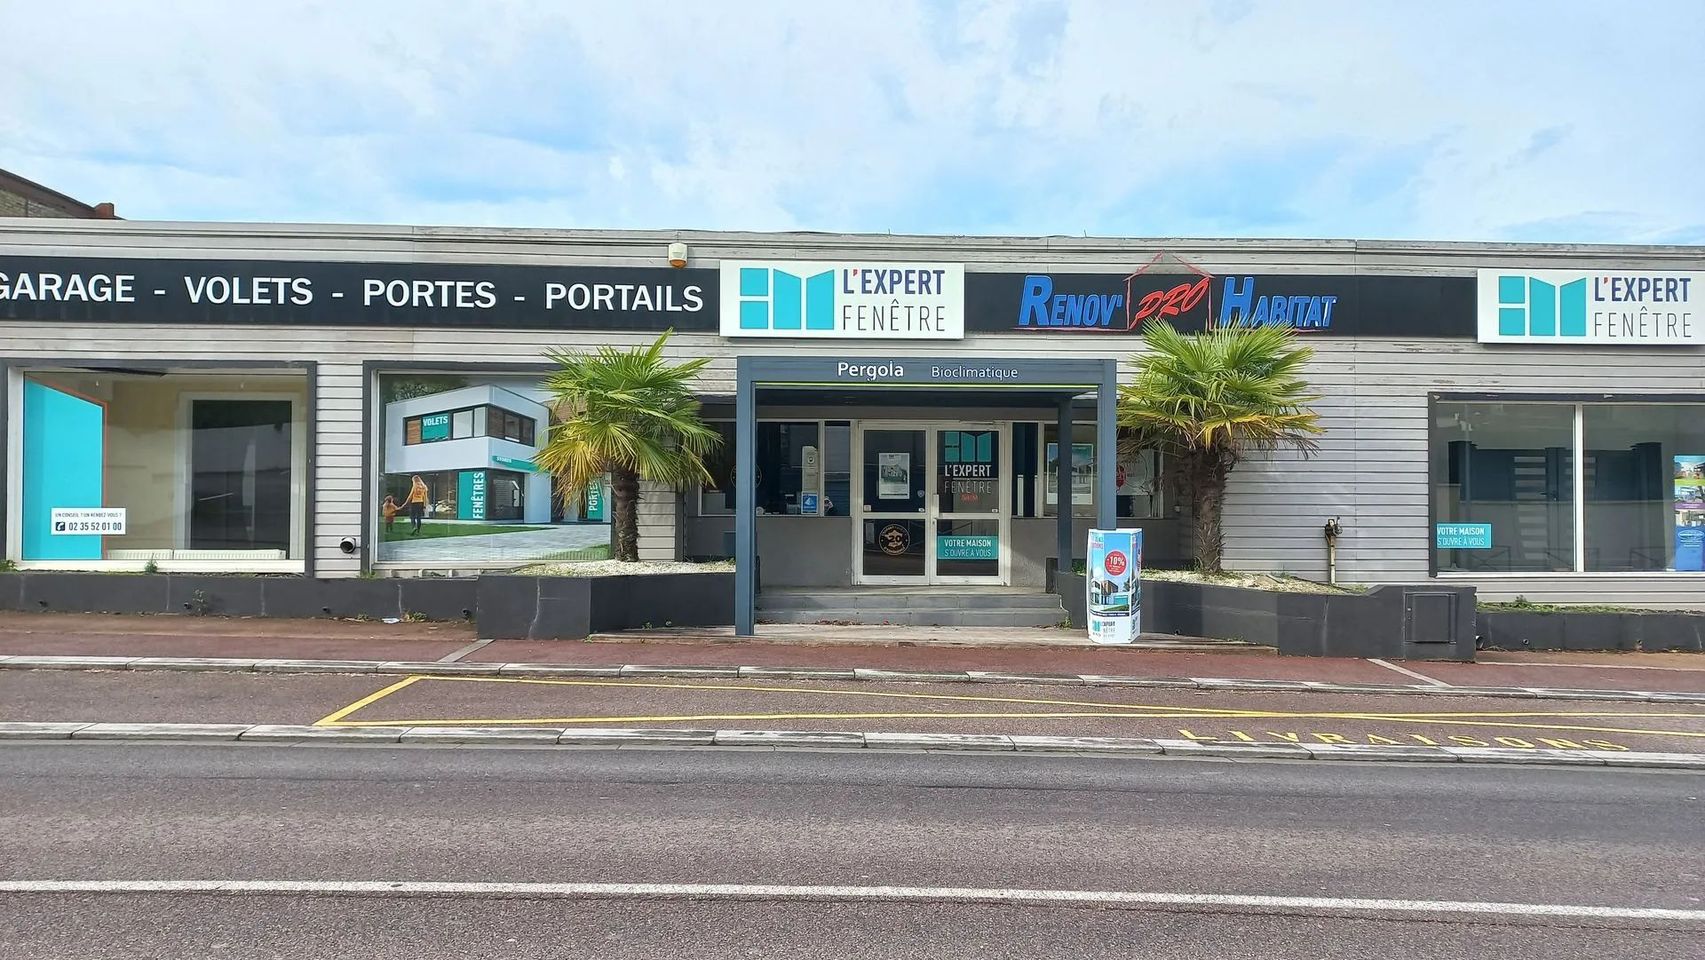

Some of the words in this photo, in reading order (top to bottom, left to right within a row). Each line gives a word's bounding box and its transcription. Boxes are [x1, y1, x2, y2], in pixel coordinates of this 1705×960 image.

[843, 269, 946, 295] L'EXPERT
[1594, 277, 1692, 302] L'EXPERT
[184, 276, 313, 305] VOLETS
[363, 279, 497, 309] PORTES
[545, 282, 704, 312] PORTAILS
[1130, 276, 1211, 330] PRO
[1219, 276, 1338, 328] HABITAT
[843, 299, 946, 331] FENÊTRE
[1594, 306, 1692, 337] FENÊTRE
[837, 361, 904, 381] Pergola
[931, 366, 1018, 381] Bioclimatique
[423, 415, 449, 427] VOLETS
[944, 464, 992, 477] L'EXPERT
[471, 472, 484, 519] FENÊTRES
[588, 480, 599, 511] PORTE
[68, 522, 78, 531] 02
[80, 522, 89, 531] 35
[91, 522, 100, 531] 52
[101, 522, 110, 531] 01
[112, 522, 122, 531] 00
[1459, 527, 1485, 535] MAISON
[944, 539, 965, 547] VOTRE
[966, 539, 992, 547] MAISON
[1469, 537, 1485, 546] VOUS
[975, 549, 992, 557] VOUS
[1178, 729, 1630, 751] LIVRAISONS
